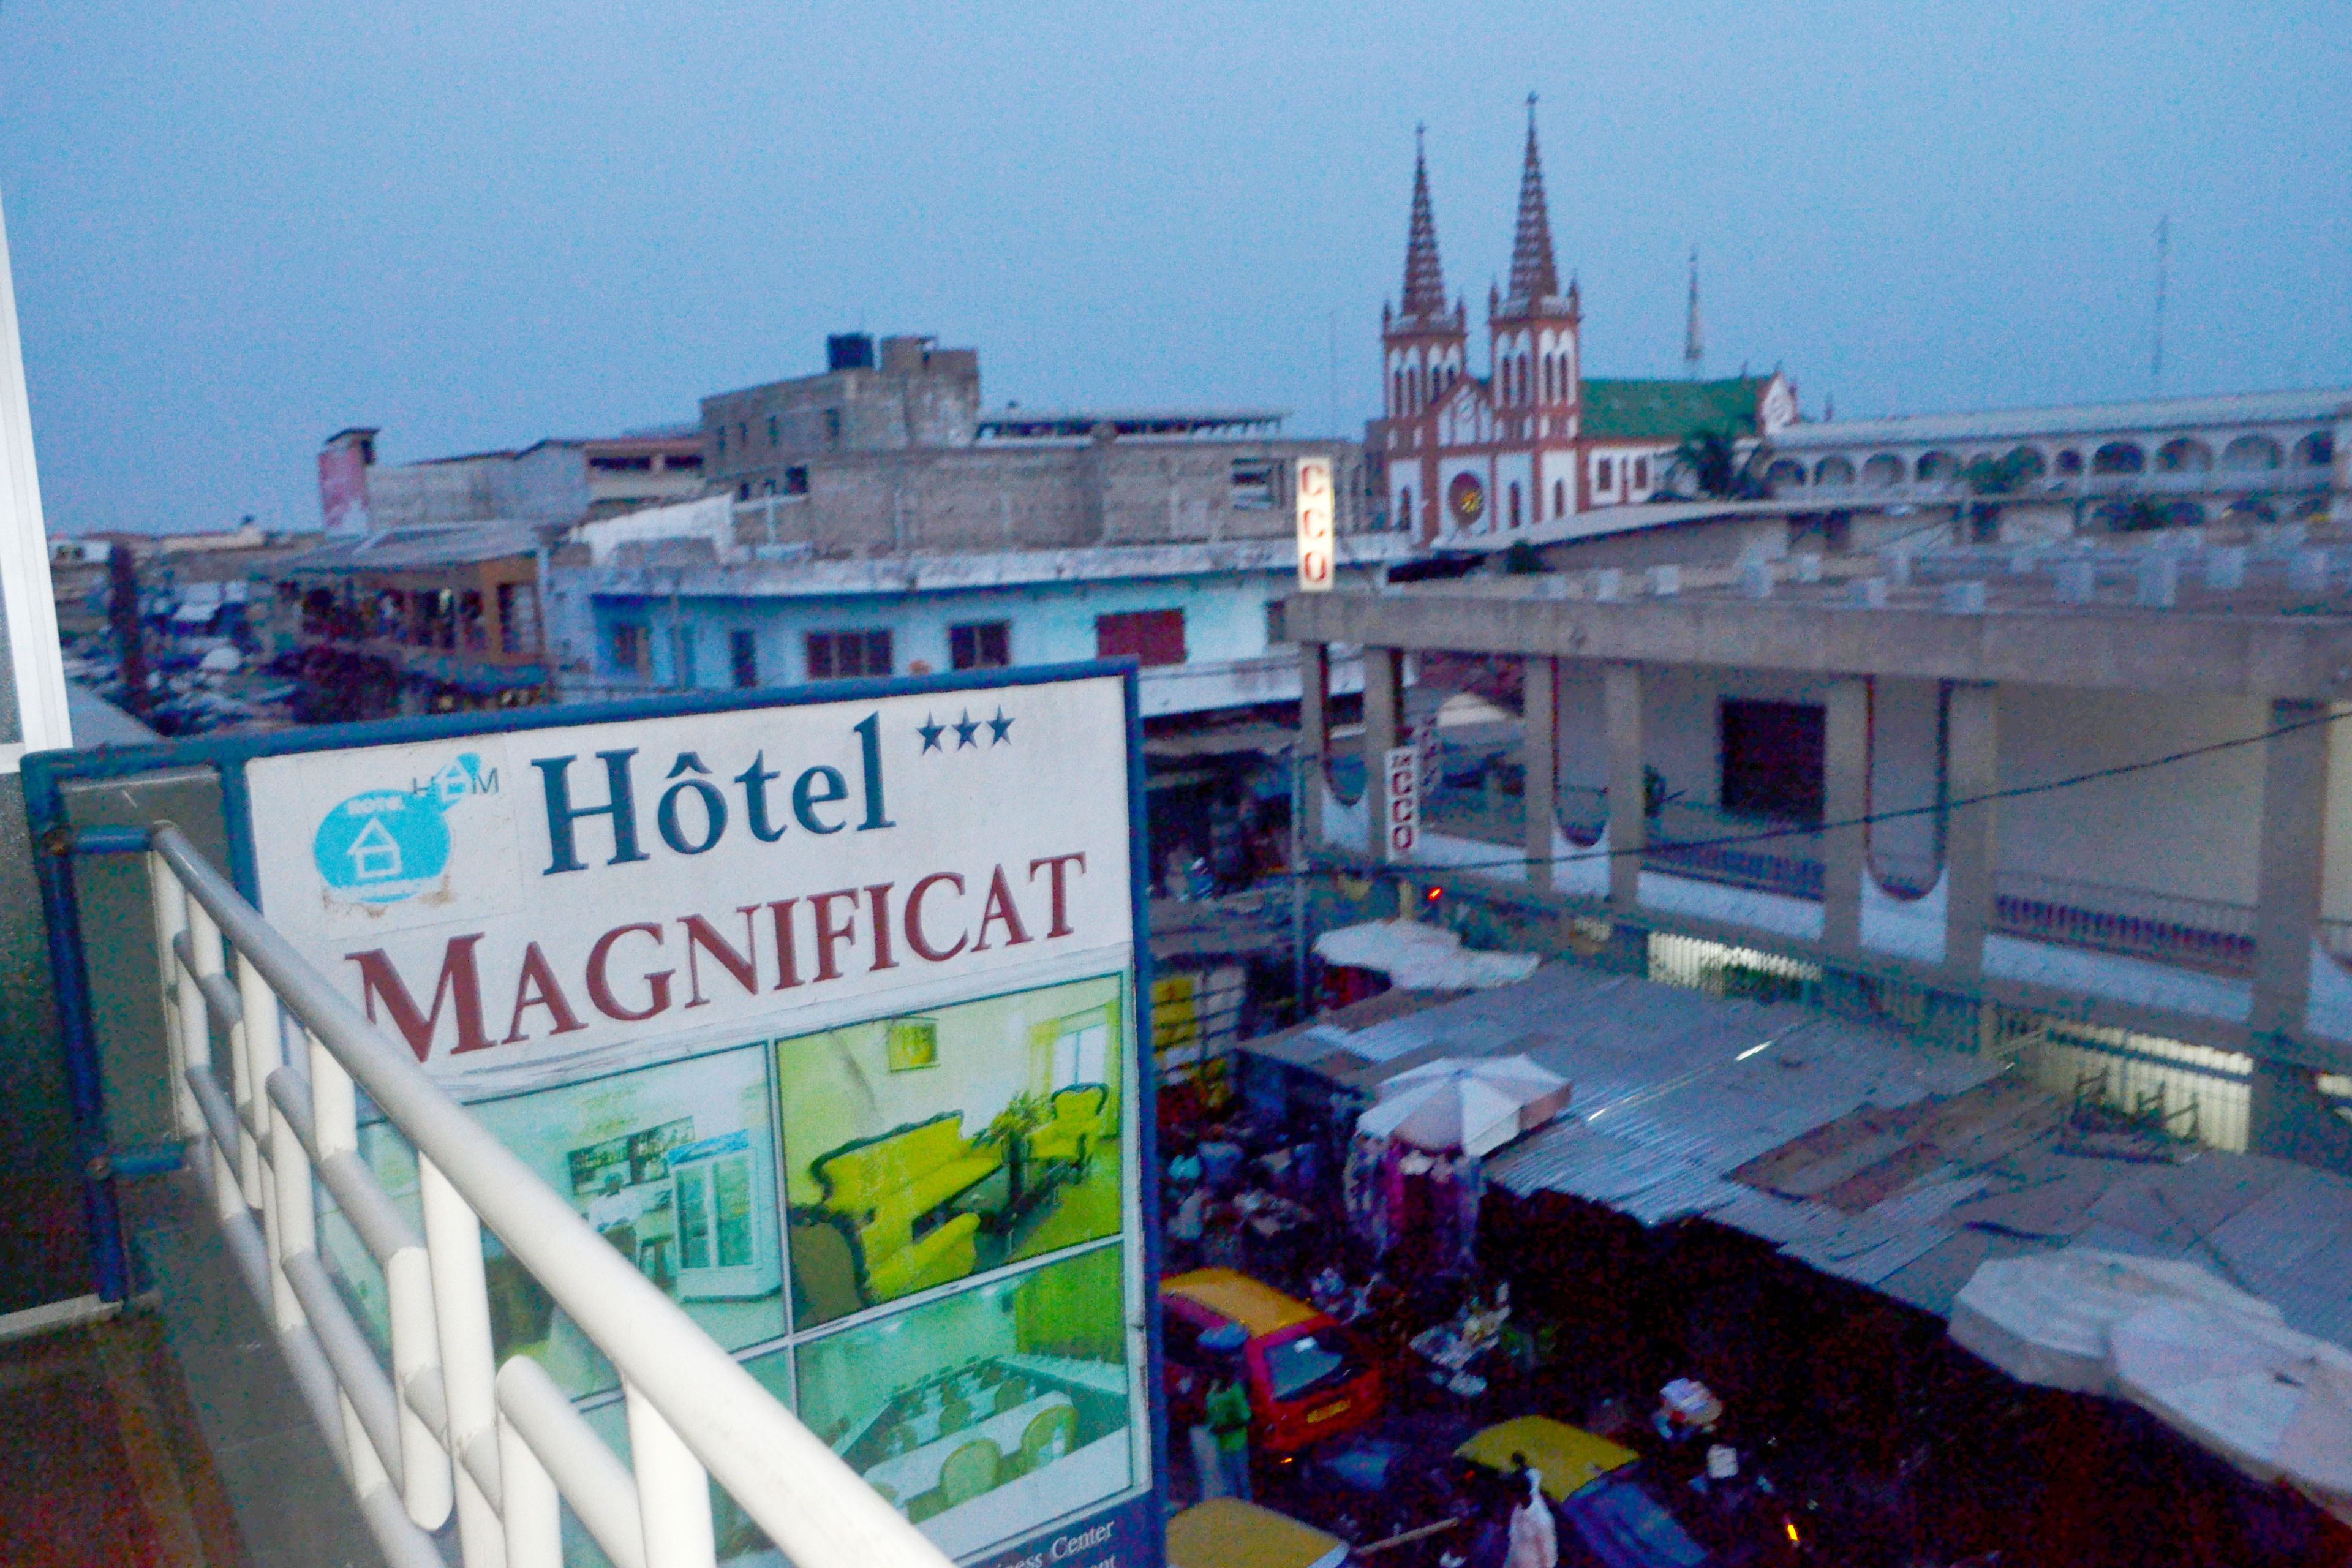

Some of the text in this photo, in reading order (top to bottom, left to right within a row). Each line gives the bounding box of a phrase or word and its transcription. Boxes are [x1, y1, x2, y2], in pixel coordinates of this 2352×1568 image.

[532, 711, 897, 875] Hôtel
[344, 851, 1087, 1063] MAGNIFICAT
[1052, 1521, 1114, 1560] Center
